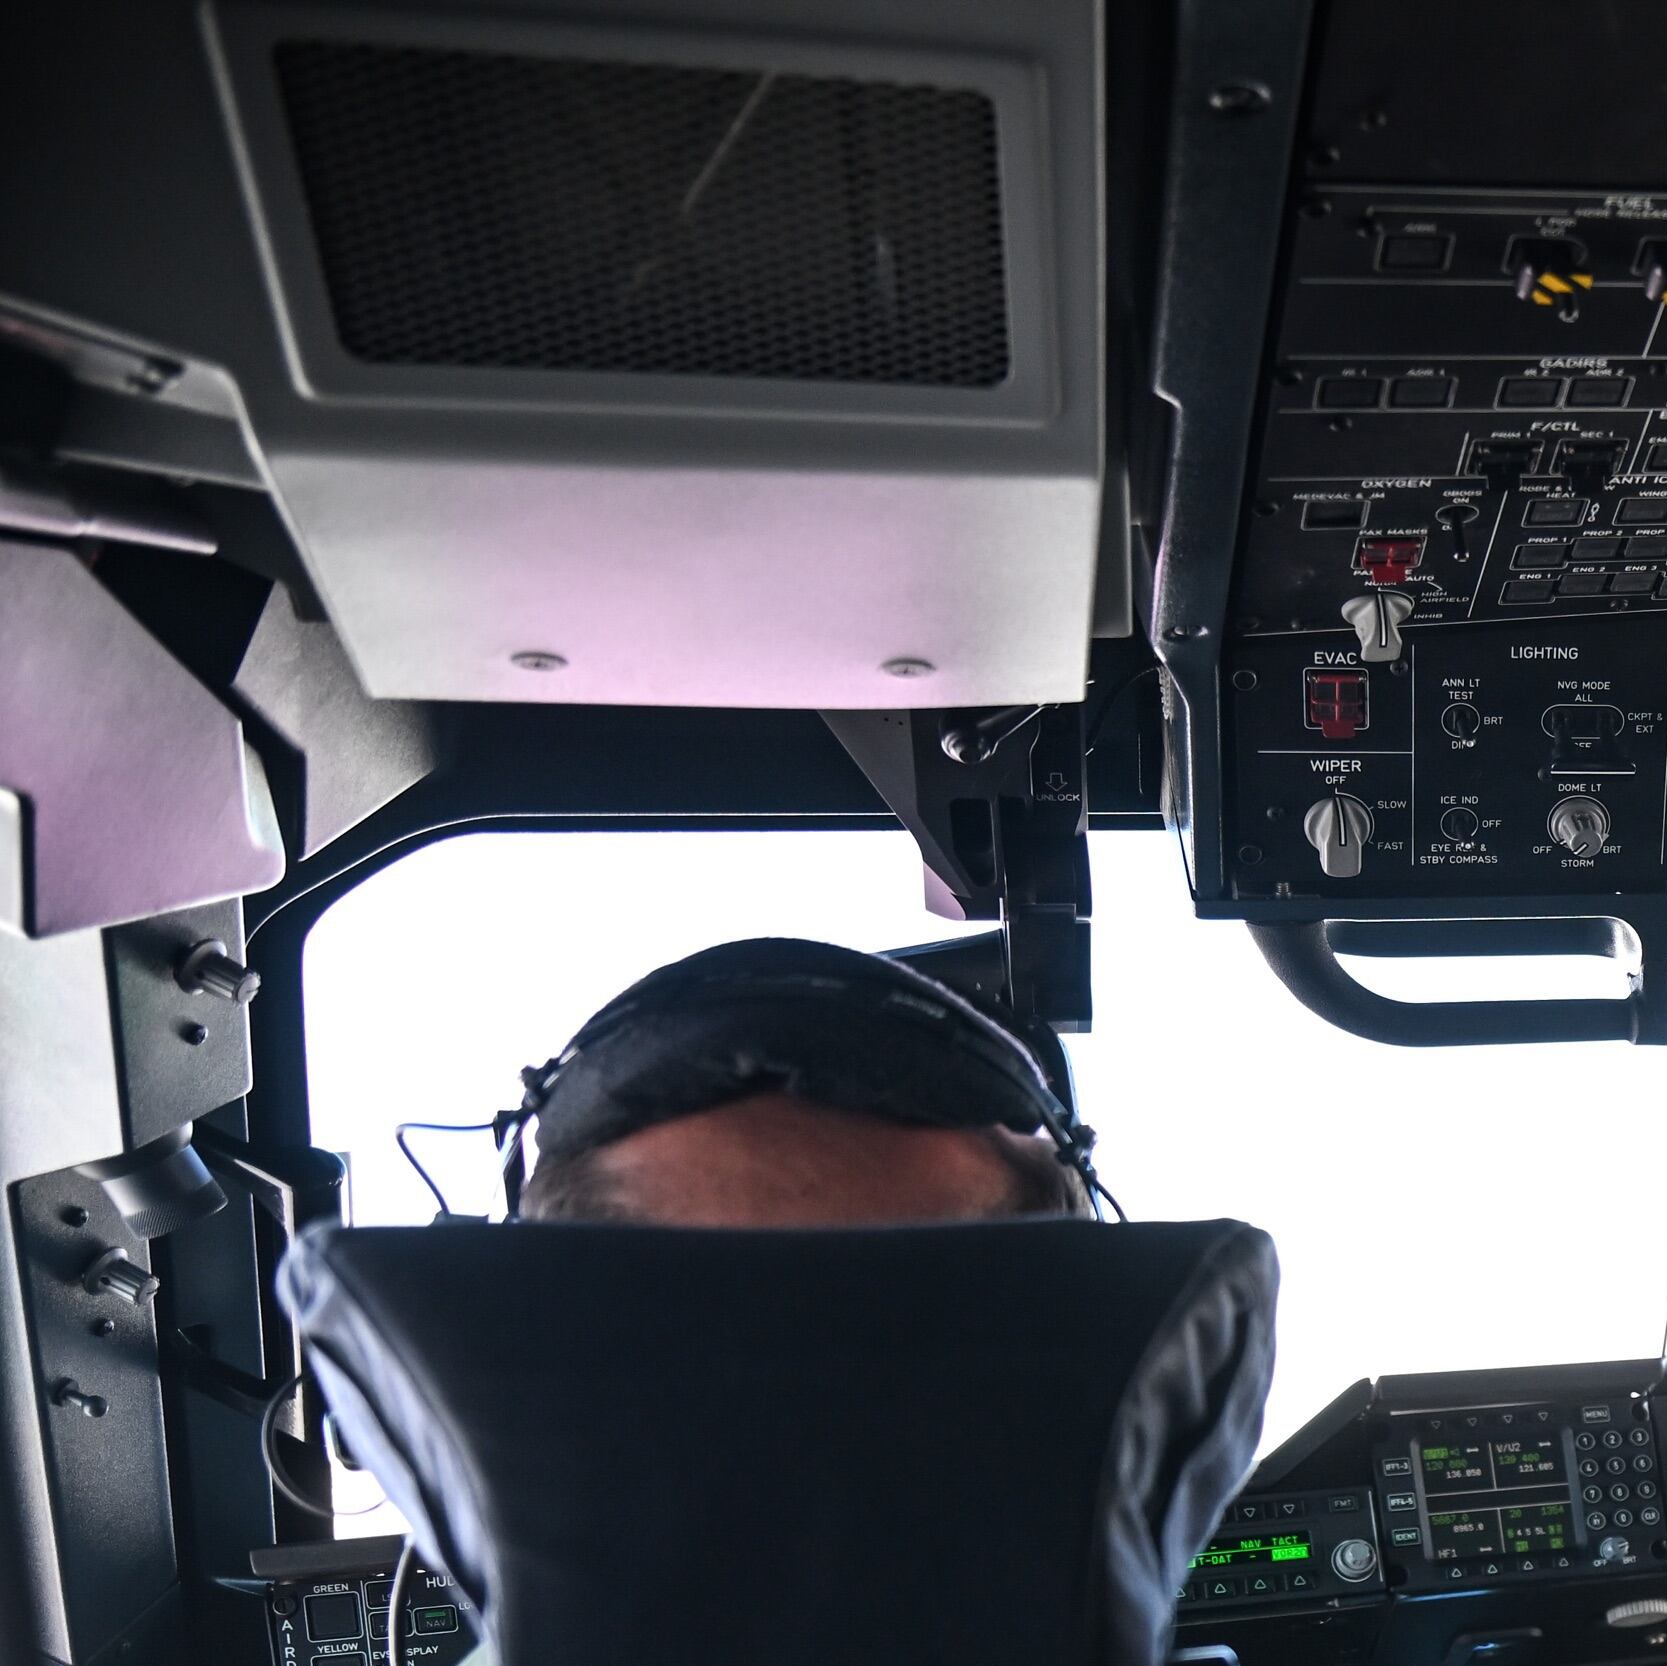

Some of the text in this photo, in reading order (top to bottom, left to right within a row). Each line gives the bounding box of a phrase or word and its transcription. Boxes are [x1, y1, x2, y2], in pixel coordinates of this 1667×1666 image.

[1530, 422, 1581, 432] F/CTL
[1361, 479, 1432, 489] OXYGEN
[1608, 476, 1647, 485] ANTI
[1314, 652, 1356, 665] EVAC
[1510, 646, 1579, 661] LIGHTING
[1442, 678, 1480, 688] ANN LT
[1558, 681, 1610, 690] NVG MODE
[1449, 690, 1473, 700] TEST
[1575, 693, 1593, 703] ALL
[1483, 716, 1503, 725] BRT
[1627, 712, 1654, 721] CKPT
[1635, 724, 1654, 734] EXT
[1310, 760, 1362, 773] WIPER
[1325, 776, 1347, 784] OFF
[1558, 783, 1602, 792] DOME LT
[1377, 800, 1407, 809] SLOW
[1440, 795, 1479, 804] ICE IND
[1377, 841, 1404, 850] FAST
[1603, 845, 1622, 855] BRT
[1420, 855, 1498, 865] STBY COMPASS
[1561, 859, 1595, 869] STORM
[1241, 1535, 1298, 1549] NAV TACT
[313, 1583, 349, 1594] GREEN
[426, 1620, 446, 1628] NAV
[318, 1642, 358, 1654] YELLOW
